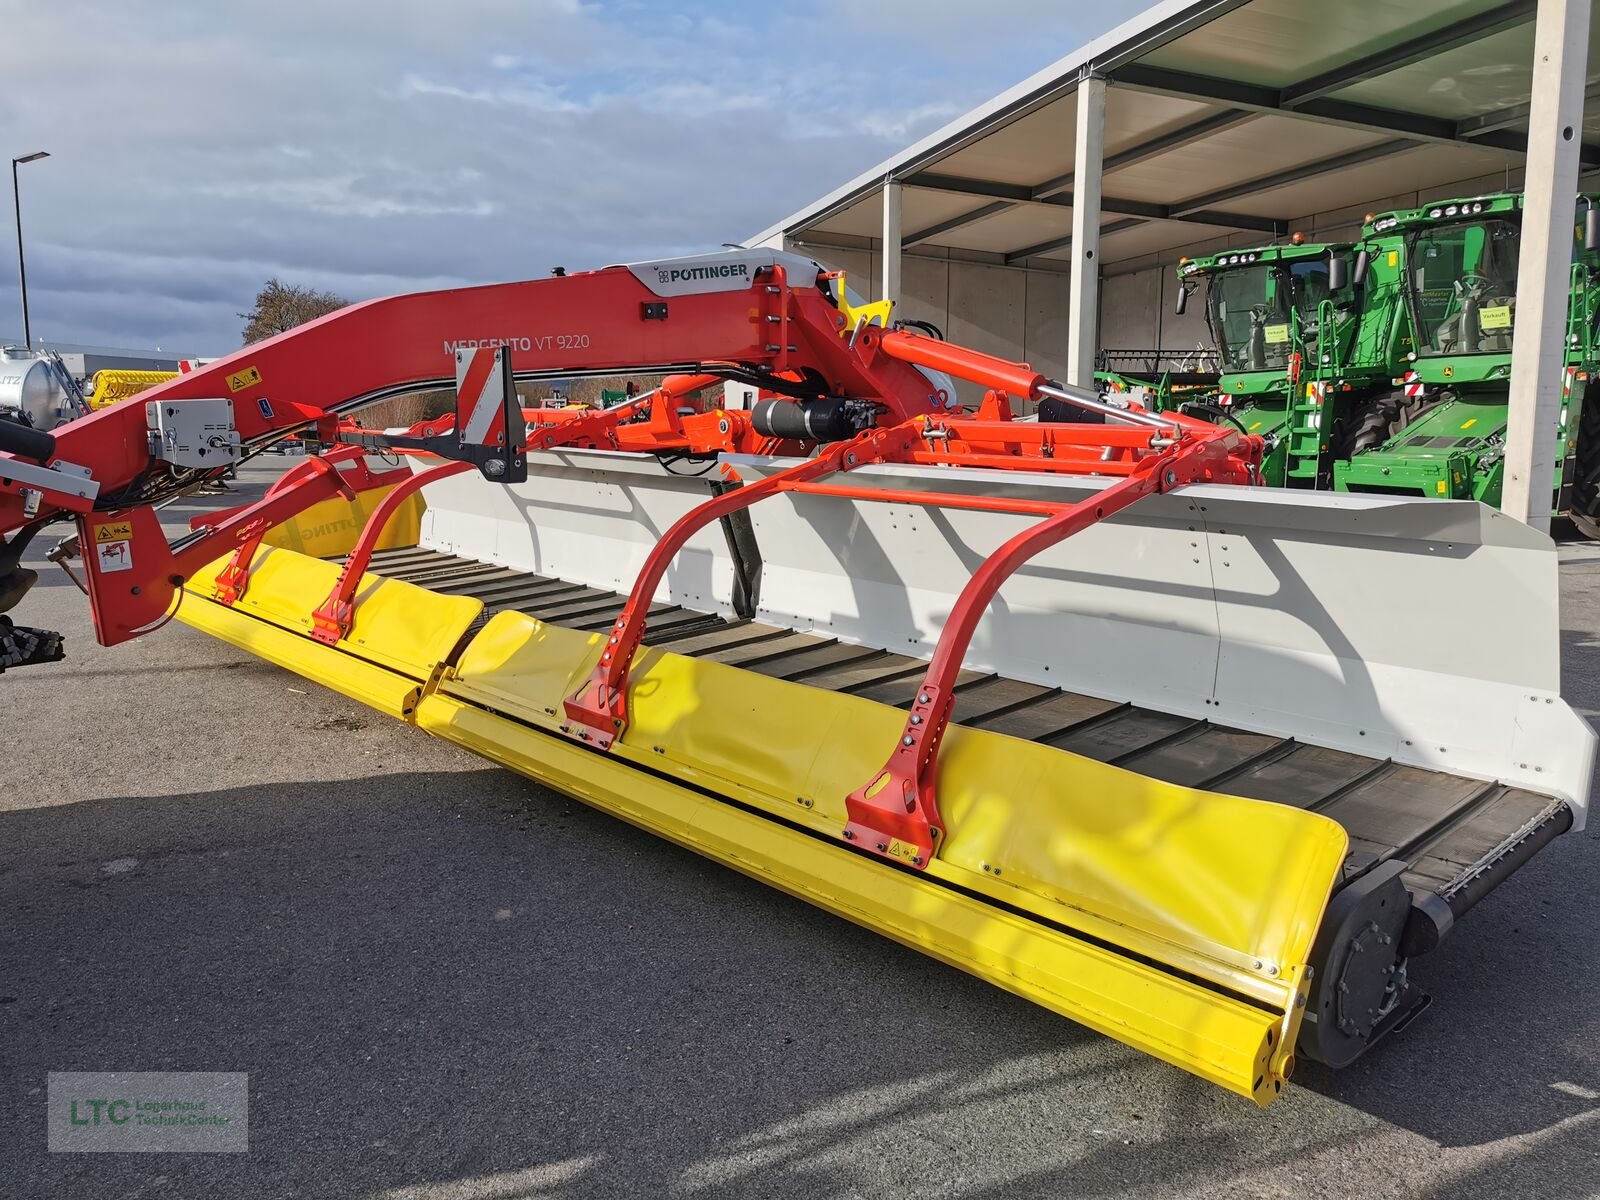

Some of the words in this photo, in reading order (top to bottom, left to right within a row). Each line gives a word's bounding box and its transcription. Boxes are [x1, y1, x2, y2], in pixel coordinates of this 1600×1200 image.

[534, 336, 553, 351] VT
[556, 335, 590, 350] 9220
[0, 375, 22, 385] ITZ
